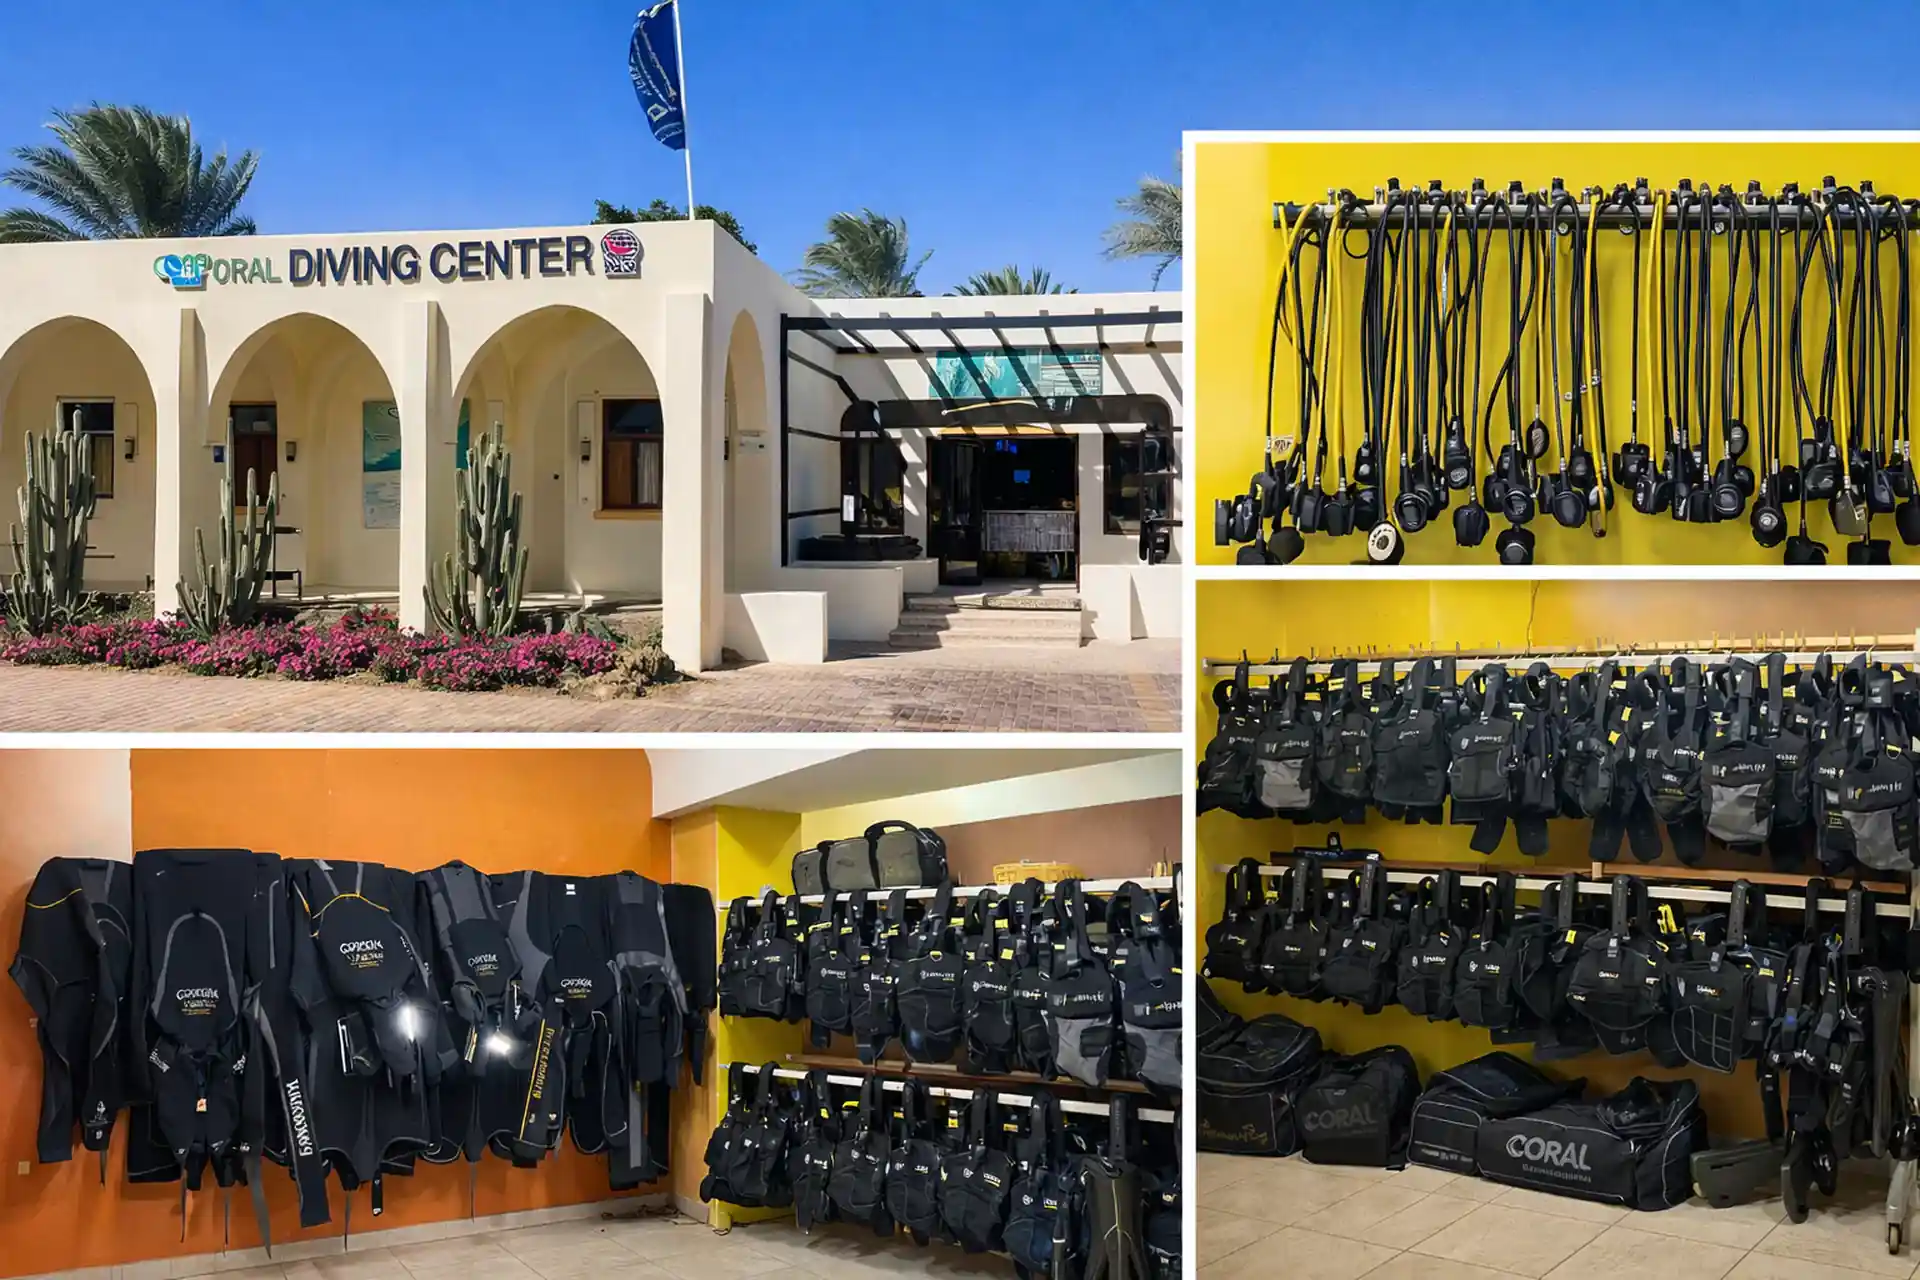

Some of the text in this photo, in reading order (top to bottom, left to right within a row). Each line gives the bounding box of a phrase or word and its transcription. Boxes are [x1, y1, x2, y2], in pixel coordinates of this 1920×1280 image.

[290, 244, 420, 283] DIVING
[430, 235, 593, 279] CENTER
[1304, 1102, 1378, 1132] CORAL
[1506, 1134, 1591, 1171] CORAL
